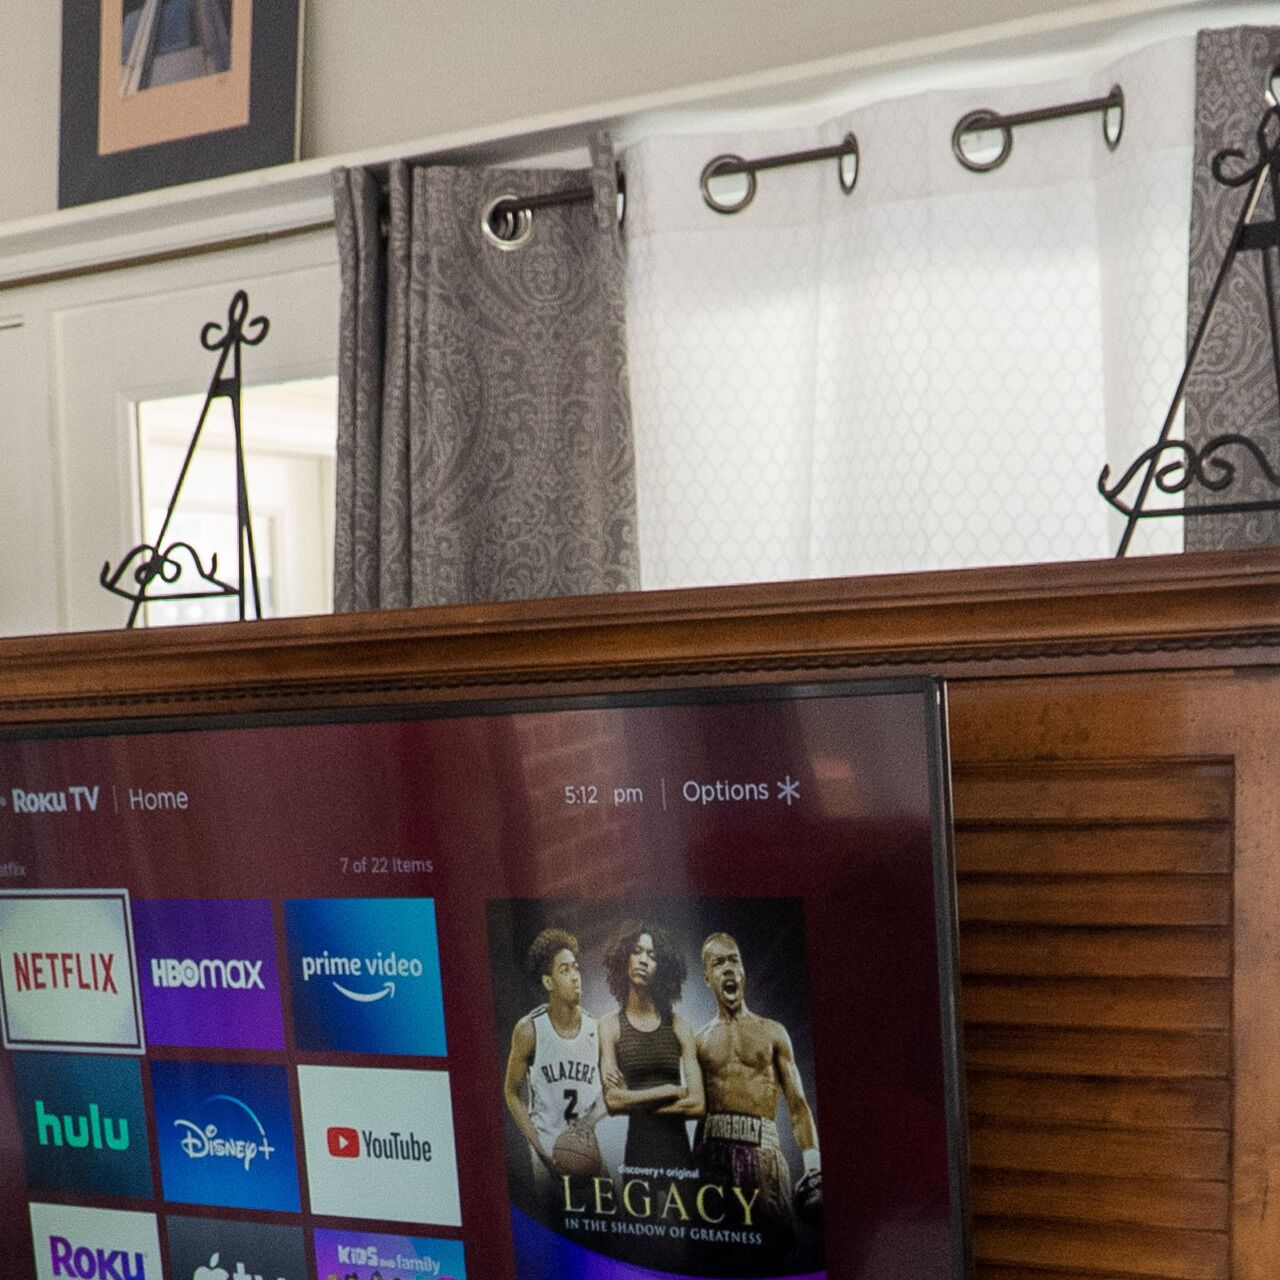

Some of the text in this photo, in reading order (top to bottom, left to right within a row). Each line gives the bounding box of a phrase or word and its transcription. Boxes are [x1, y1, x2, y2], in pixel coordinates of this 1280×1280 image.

[68, 785, 99, 812] TV
[128, 787, 189, 810] Home
[565, 780, 770, 806] 5:12 pm Options
[340, 857, 434, 874] 7 of 22 Items
[13, 951, 118, 995] NETFLIX
[302, 950, 423, 982] prime video
[542, 1060, 596, 1084] BLAZERS
[562, 1089, 579, 1121] 2
[34, 1100, 130, 1151] hulu
[362, 1130, 433, 1162] YouTube
[562, 1175, 761, 1226] LEGACY
[565, 1218, 762, 1245] IN THE SHADOW OF GREATNESS
[396, 1254, 440, 1275] family
